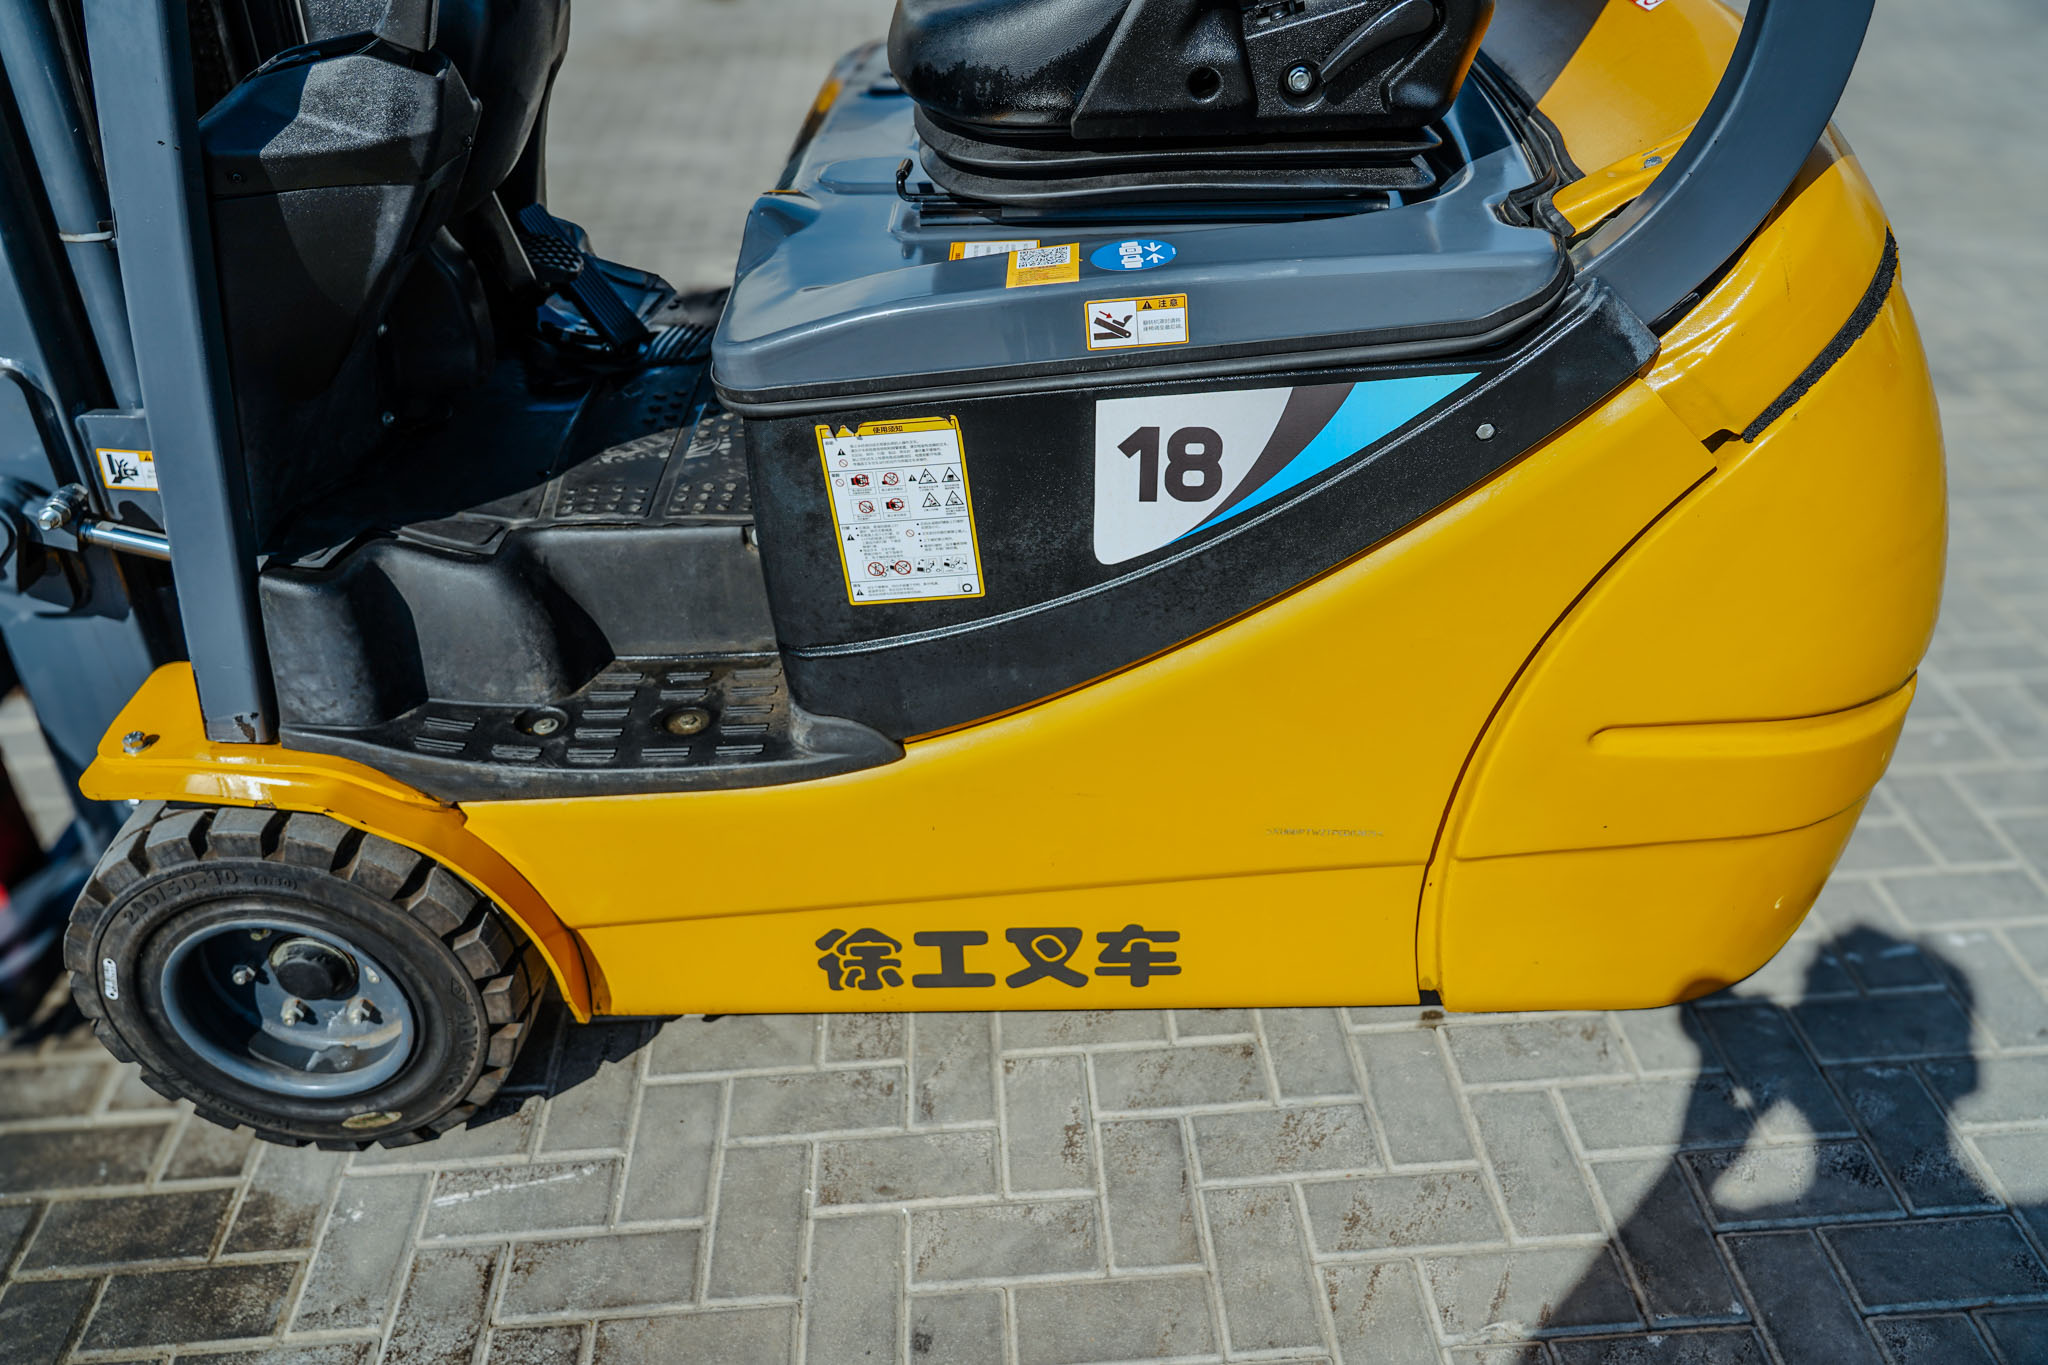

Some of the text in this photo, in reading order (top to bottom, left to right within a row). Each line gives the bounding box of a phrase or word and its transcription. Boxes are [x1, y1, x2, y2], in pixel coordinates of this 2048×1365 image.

[1158, 298, 1179, 308] 注意
[872, 425, 904, 434] 使用须知
[1117, 425, 1223, 503] 18
[815, 923, 1182, 991] 徐工叉车
